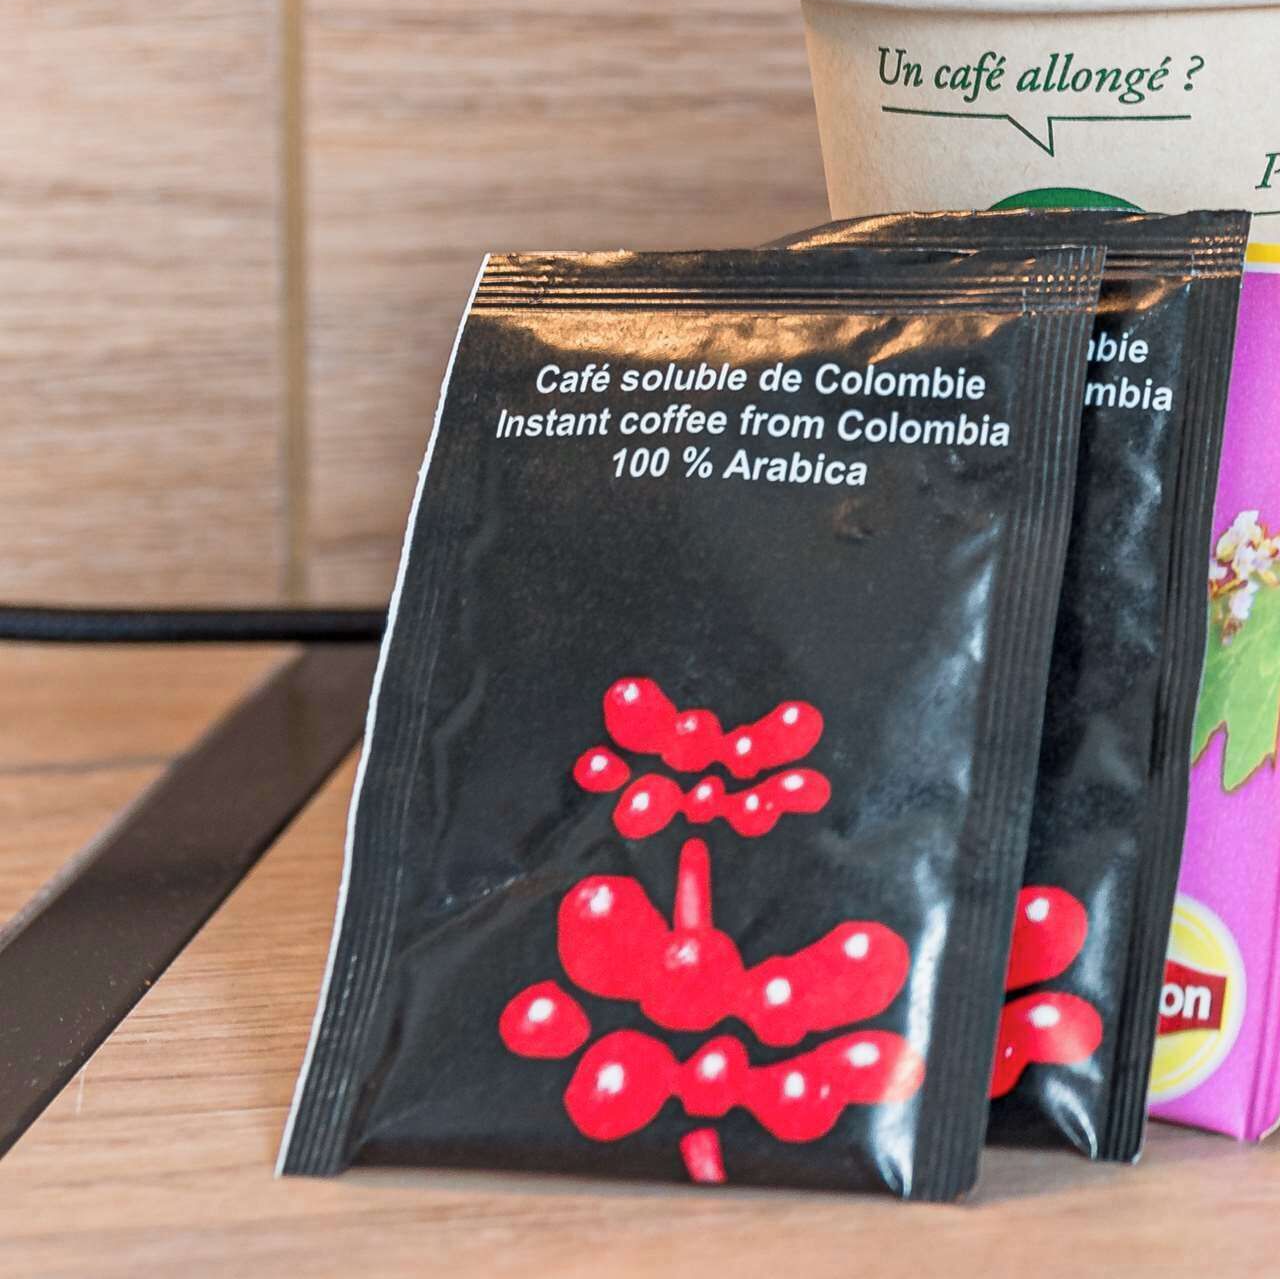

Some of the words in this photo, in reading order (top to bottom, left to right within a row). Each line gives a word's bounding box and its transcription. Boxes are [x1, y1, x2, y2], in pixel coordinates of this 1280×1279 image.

[877, 46, 923, 87] Un
[934, 51, 1007, 103] café
[1016, 53, 1172, 105] allongé
[1183, 55, 1205, 92] ?
[535, 363, 611, 394] Café
[620, 363, 749, 394] soluble
[757, 363, 803, 394] de
[814, 363, 987, 400] Colombie
[1084, 376, 1174, 412] mbia
[496, 407, 611, 439] Instant
[619, 403, 729, 436] coffee
[740, 405, 826, 441] from
[836, 409, 1012, 448] Colombia
[610, 448, 670, 479] 100
[681, 447, 715, 479] %
[722, 448, 869, 488] Arabica
[1159, 983, 1212, 1021] on
